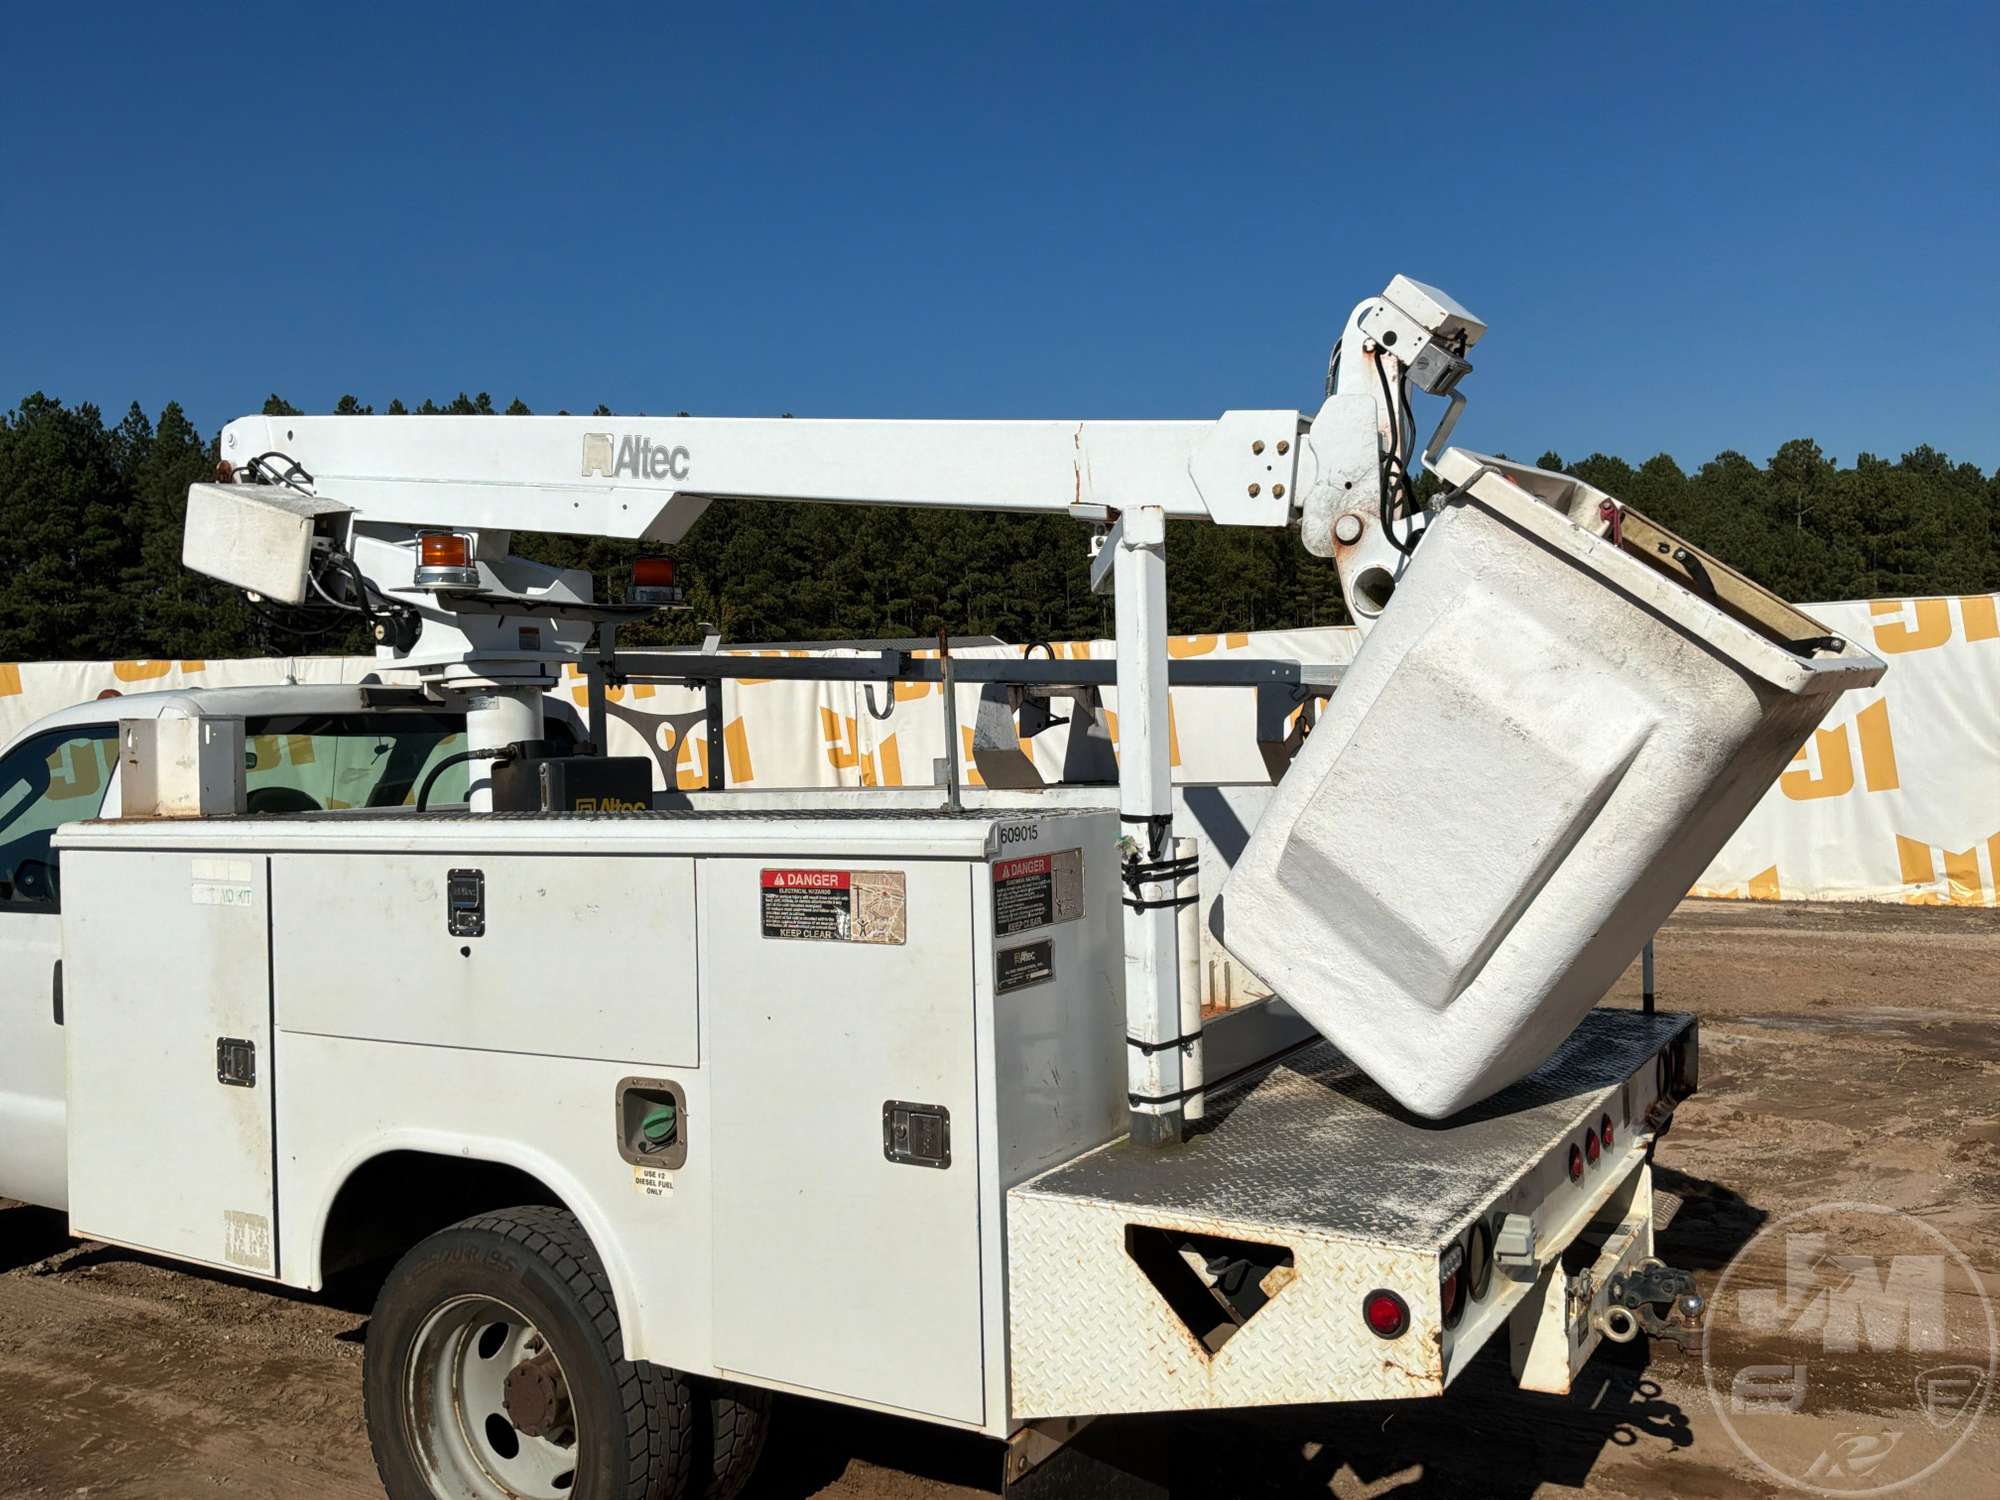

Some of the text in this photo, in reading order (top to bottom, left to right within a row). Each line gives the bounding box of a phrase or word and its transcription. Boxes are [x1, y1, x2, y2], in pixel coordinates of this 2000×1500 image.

[614, 435, 690, 481] Altec
[1001, 825, 1038, 844] 609015
[1012, 860, 1044, 876] DANGER
[787, 874, 838, 886] DANGER
[780, 929, 832, 939] KEEP CLEAR
[635, 1177, 674, 1189] DIESEL FUEL
[647, 1187, 662, 1195] ONLY
